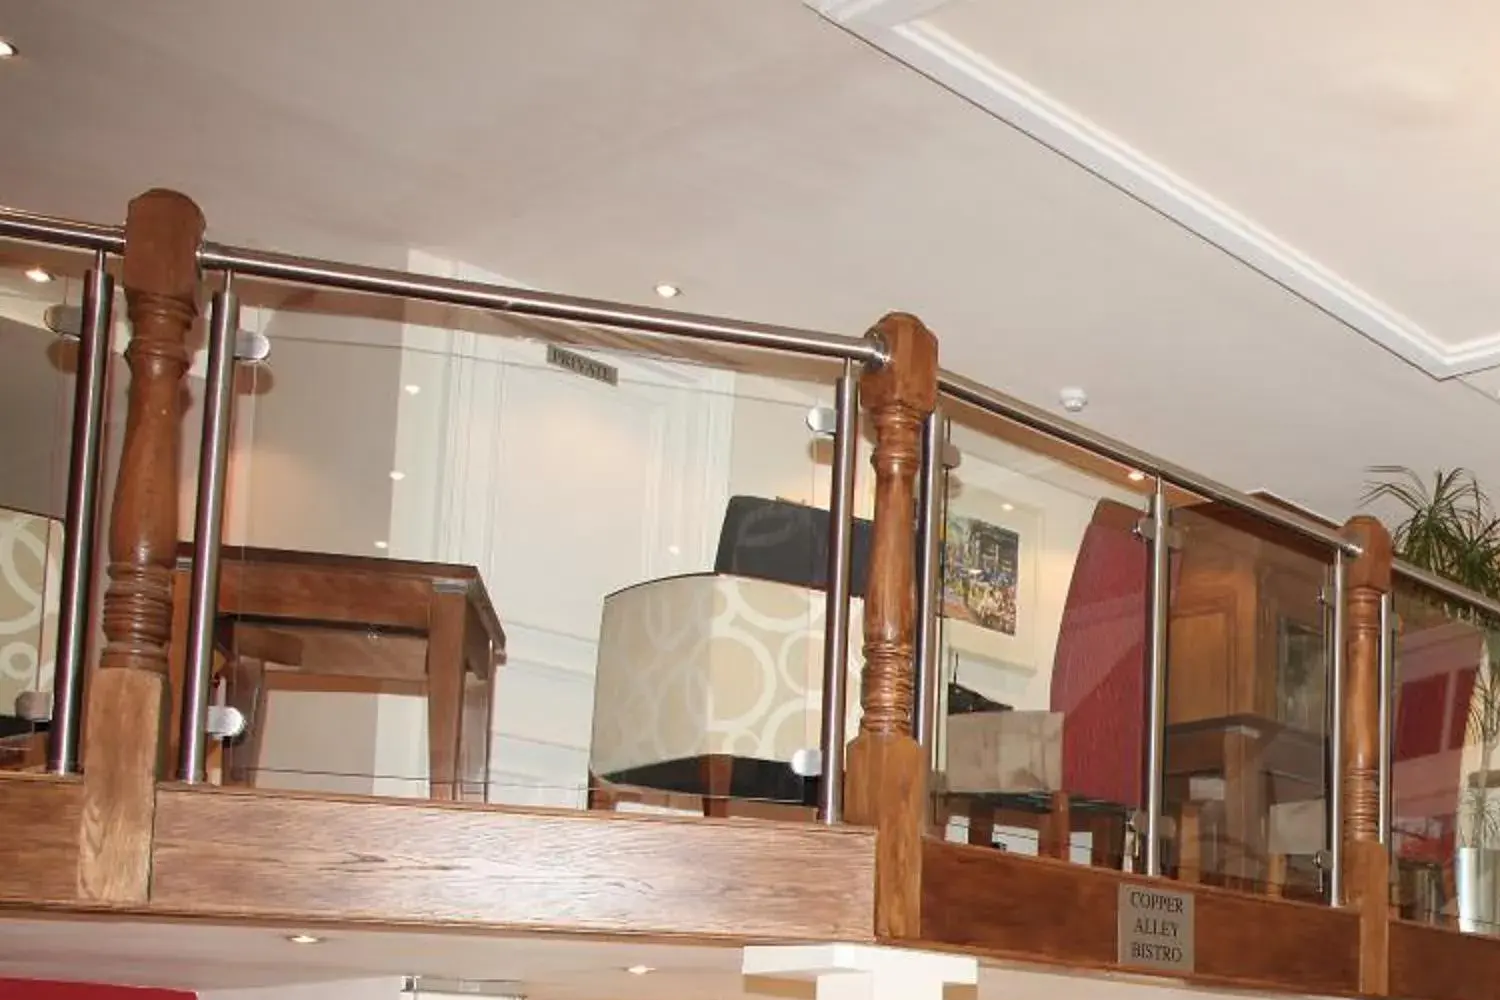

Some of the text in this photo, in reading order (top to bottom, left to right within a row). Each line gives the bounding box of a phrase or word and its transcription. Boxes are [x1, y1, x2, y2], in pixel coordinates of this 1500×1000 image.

[1130, 890, 1184, 914] COPPER
[1133, 917, 1179, 938] ALLEY
[1131, 941, 1183, 962] BISTRO
